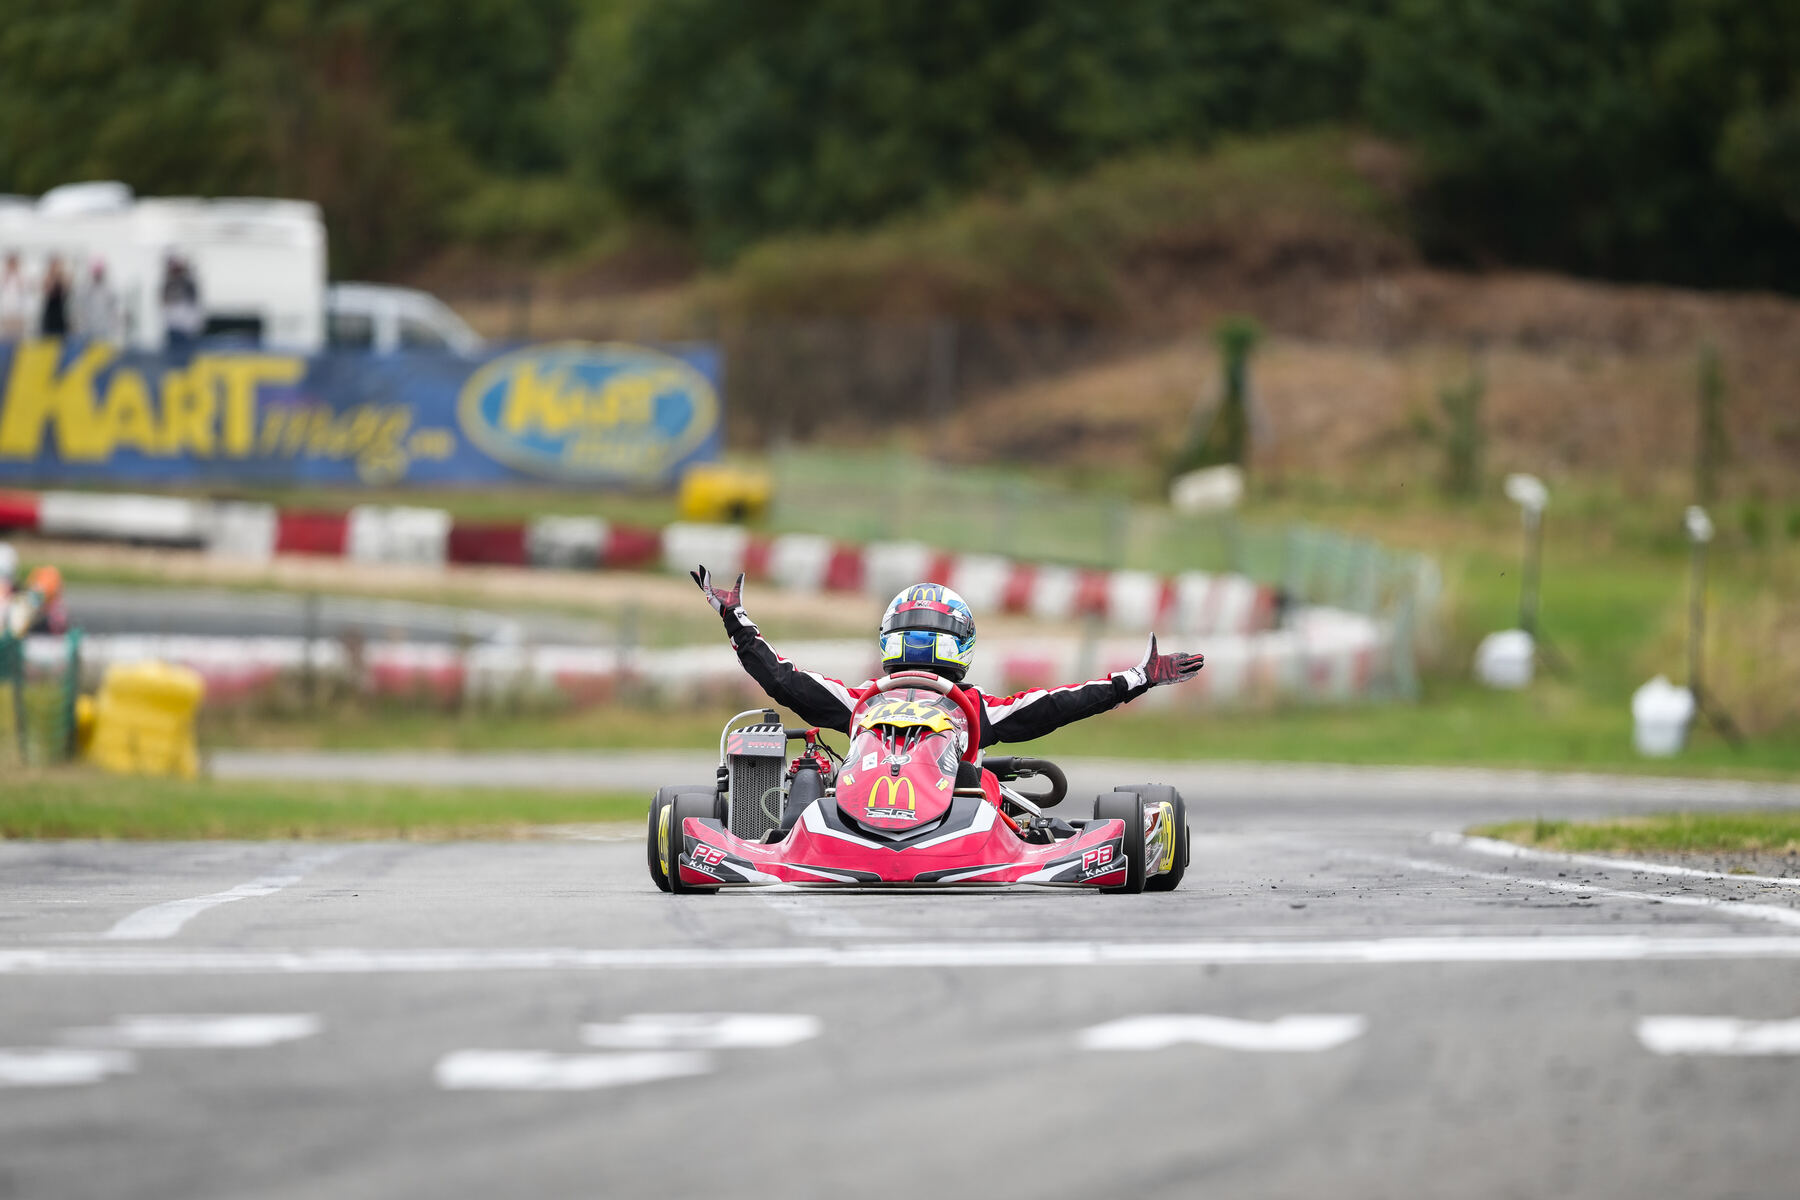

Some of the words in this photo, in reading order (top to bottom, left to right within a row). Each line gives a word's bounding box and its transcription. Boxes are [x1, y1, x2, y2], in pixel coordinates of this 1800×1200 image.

[871, 702, 941, 722] 447
[691, 843, 728, 867] PB
[1082, 845, 1114, 871] PB
[688, 860, 717, 874] KART
[1085, 863, 1116, 878] KART
